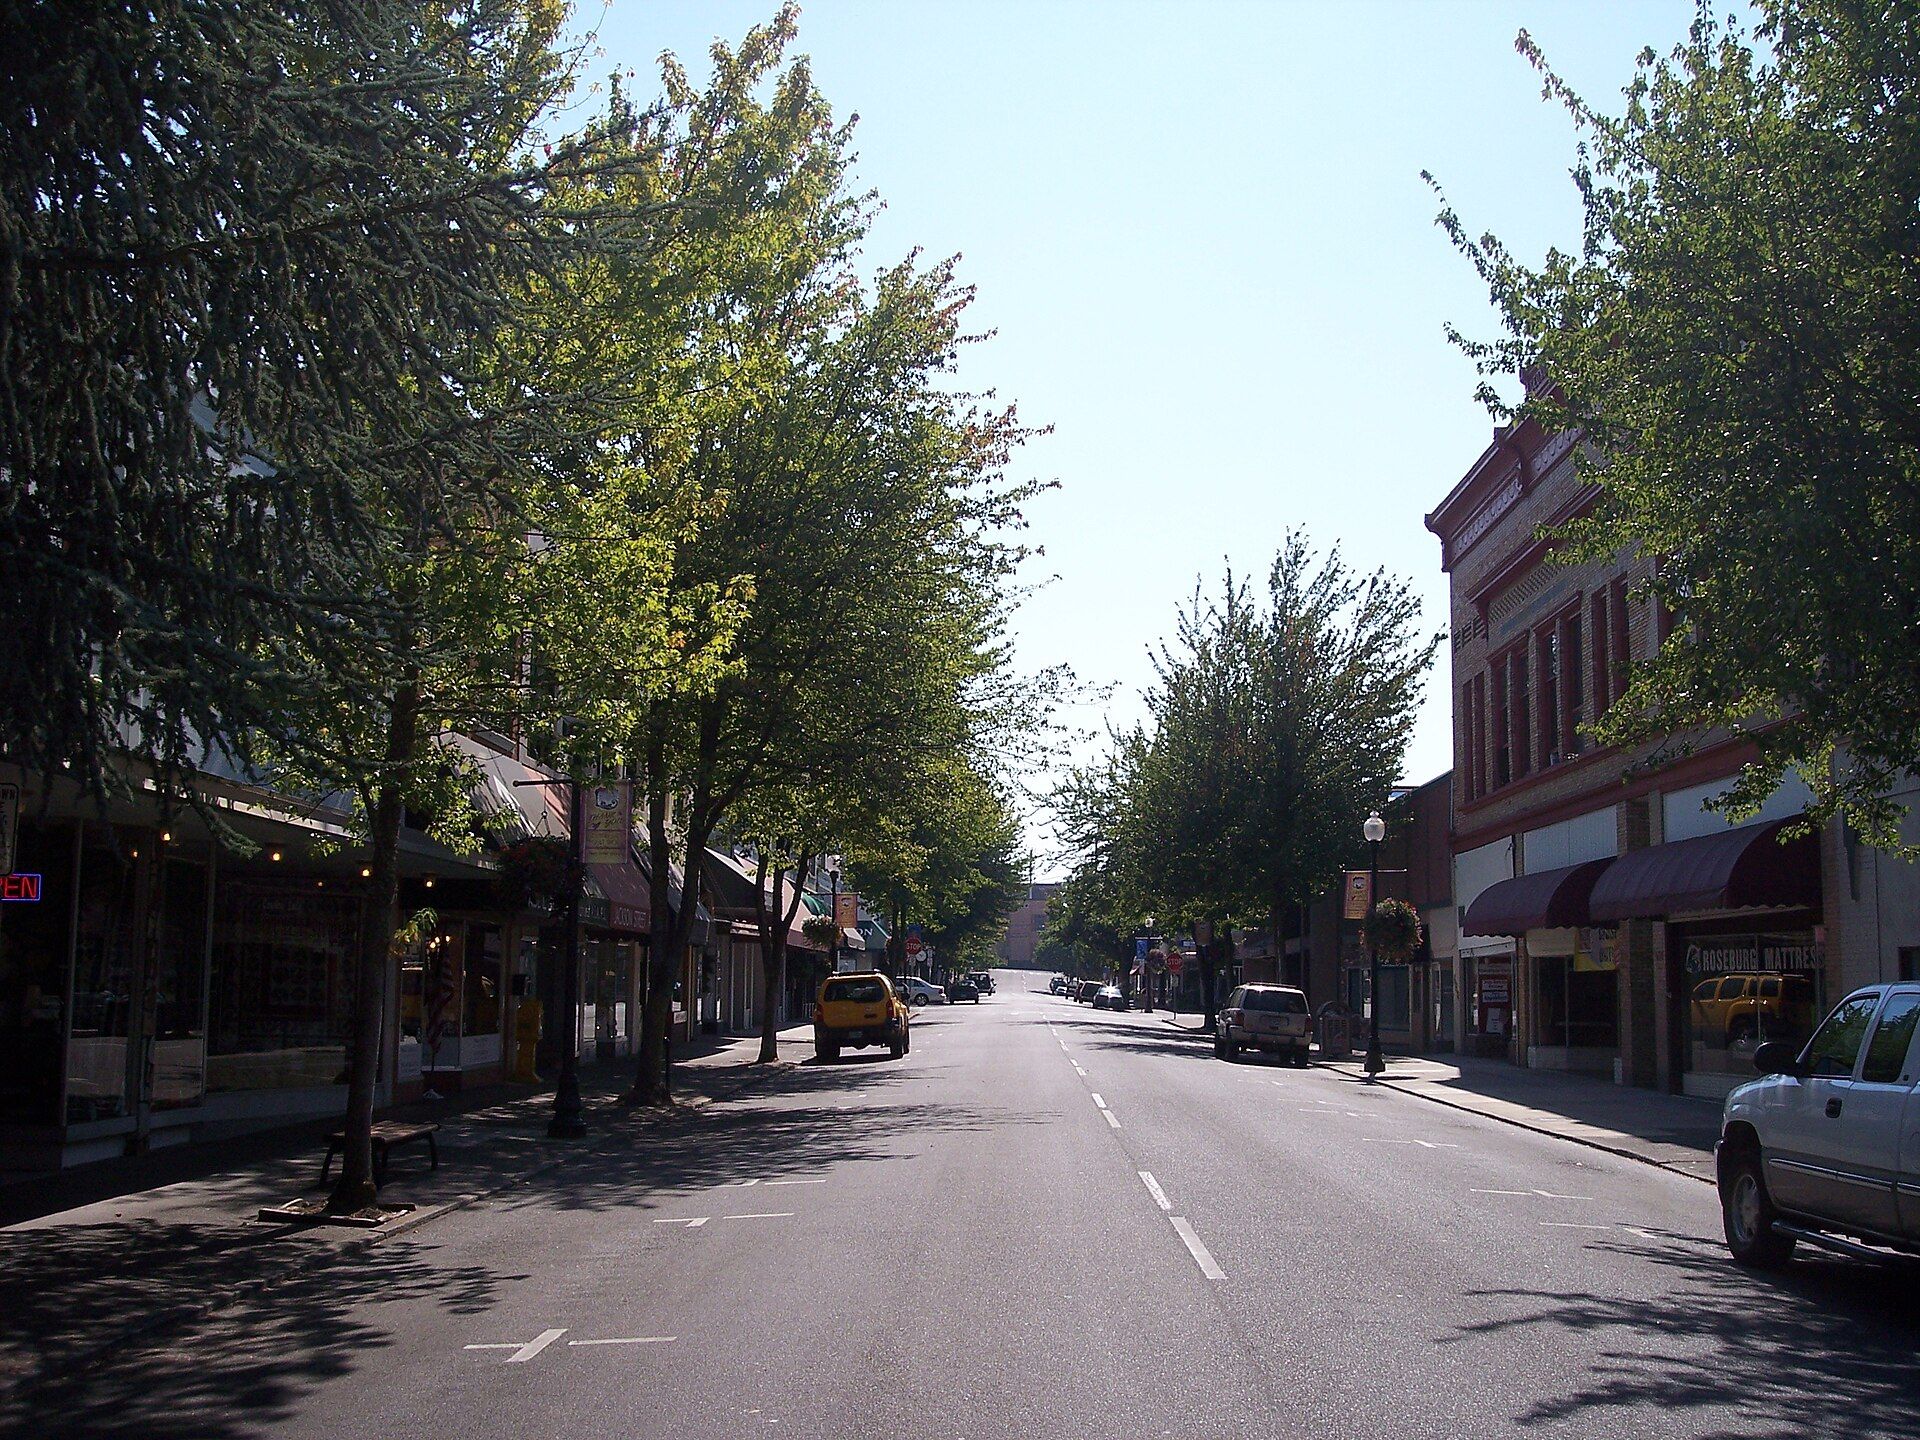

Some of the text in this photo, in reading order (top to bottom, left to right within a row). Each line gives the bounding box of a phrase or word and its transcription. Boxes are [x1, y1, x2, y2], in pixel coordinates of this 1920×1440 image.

[0, 876, 38, 898] EN
[857, 928, 873, 936] ON
[906, 942, 920, 950] STOP
[1168, 957, 1182, 966] STOP
[1702, 948, 1759, 970] ROSEBURG
